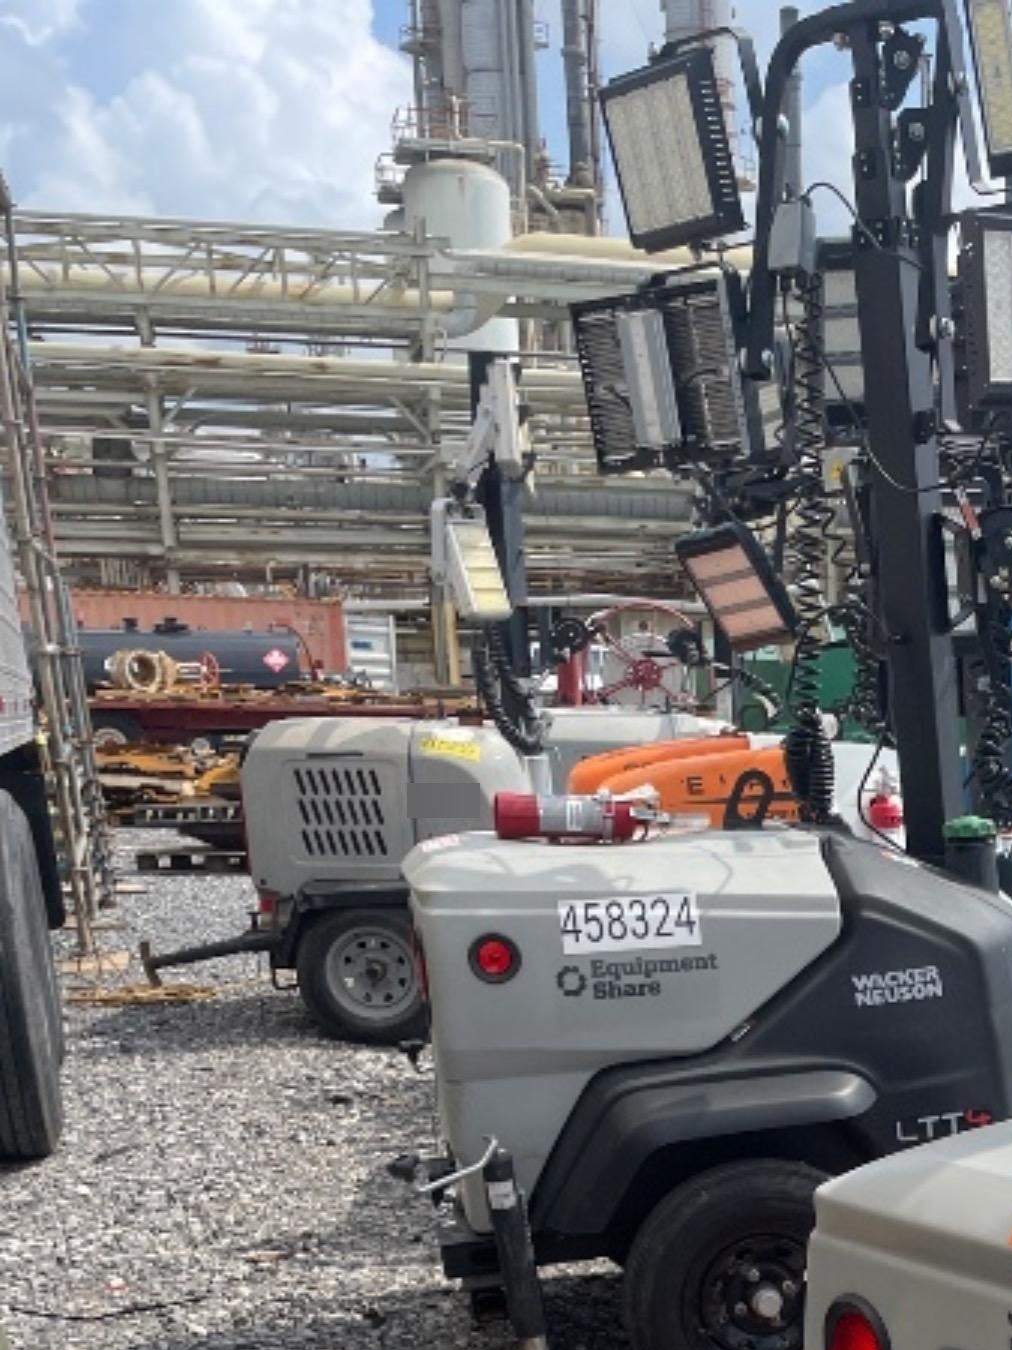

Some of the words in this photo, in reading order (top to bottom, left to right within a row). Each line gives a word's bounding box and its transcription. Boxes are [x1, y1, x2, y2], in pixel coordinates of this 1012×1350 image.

[561, 896, 696, 942] 458324
[590, 954, 718, 980] Equipment
[851, 965, 940, 991] WACKER
[593, 981, 661, 999] Share
[854, 983, 943, 1007] NEUSON
